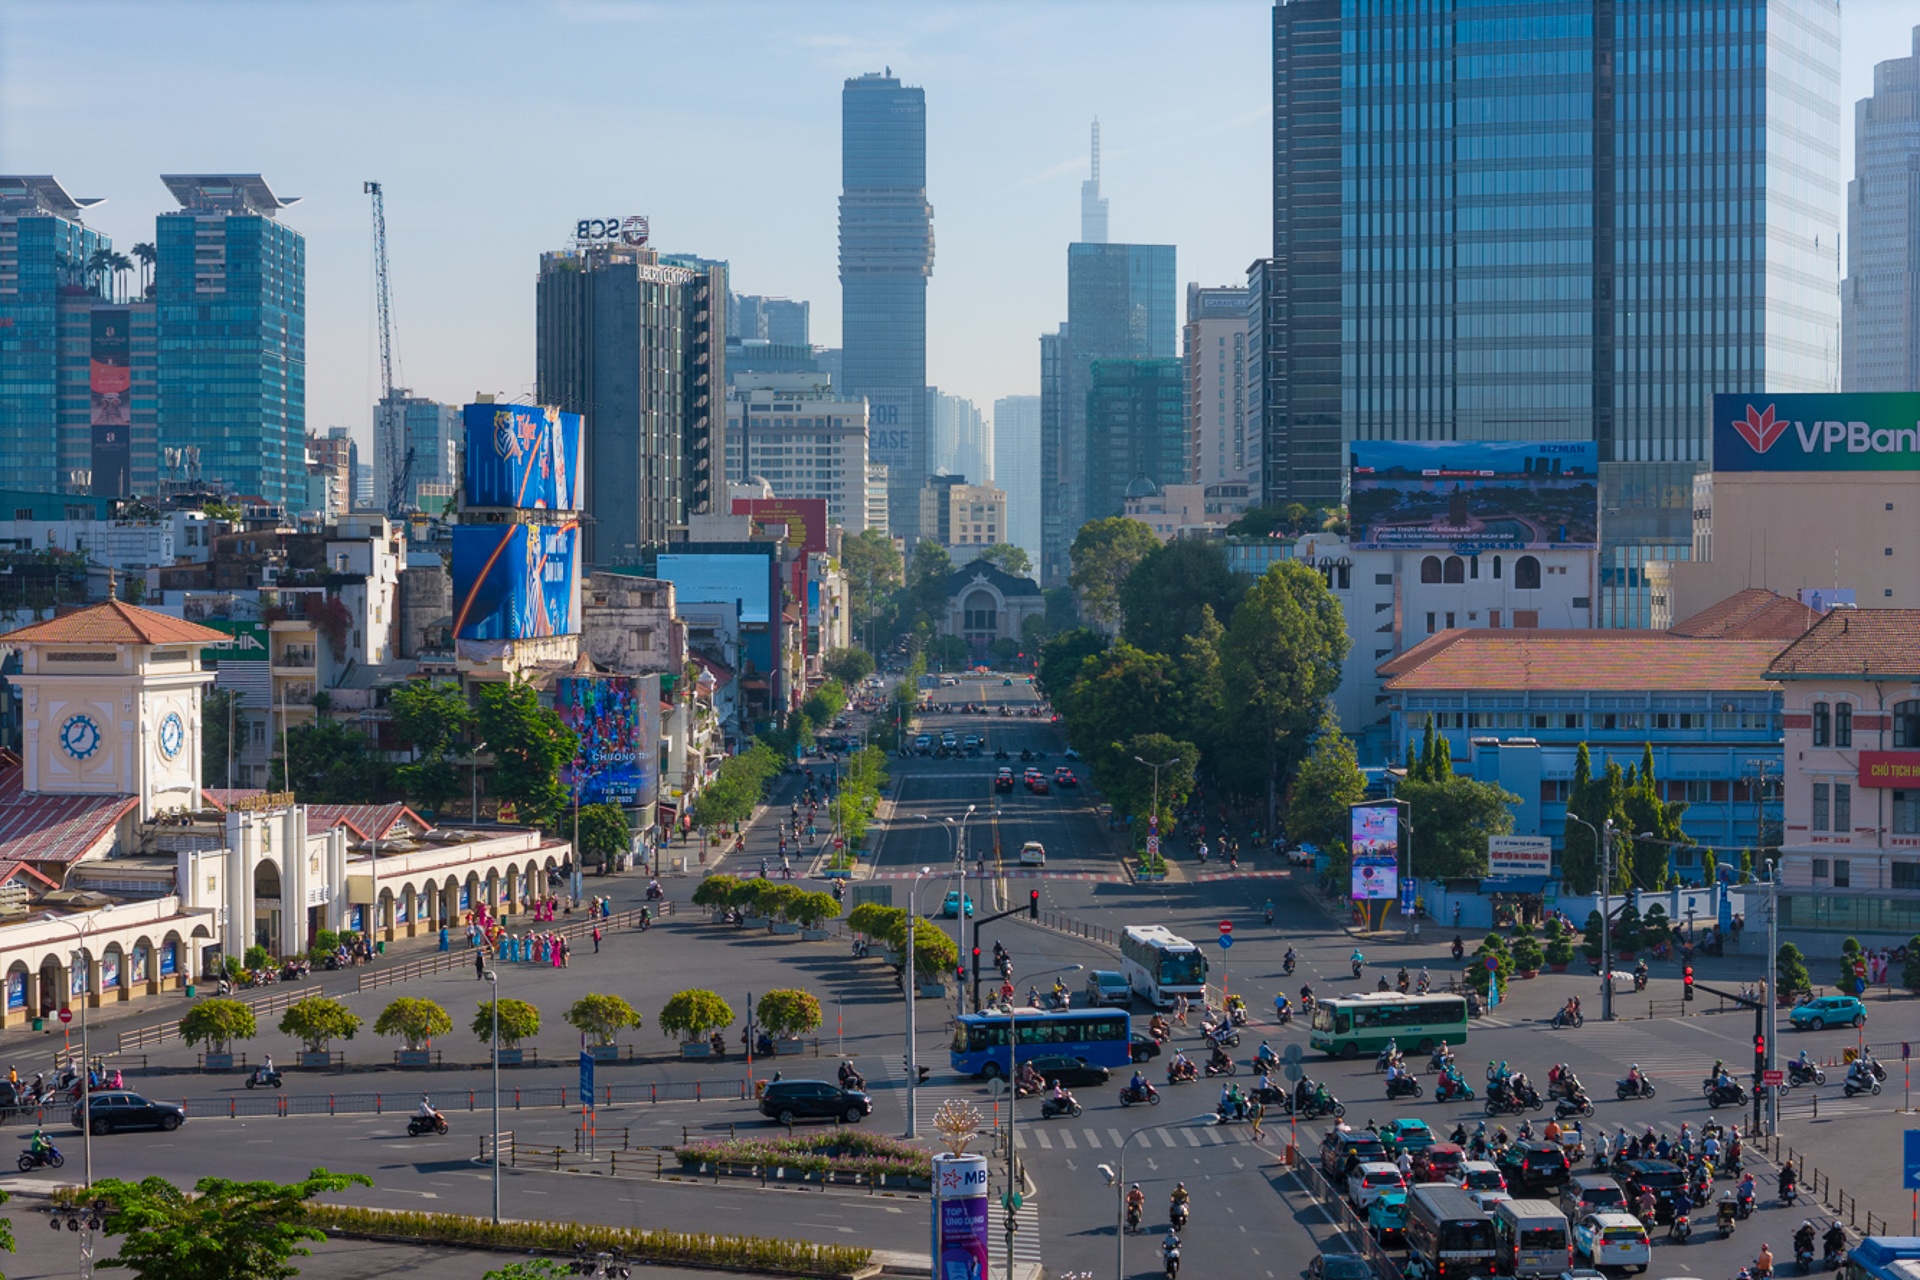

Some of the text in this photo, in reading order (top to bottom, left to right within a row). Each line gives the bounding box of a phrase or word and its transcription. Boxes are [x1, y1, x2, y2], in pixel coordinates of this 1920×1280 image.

[1794, 420, 1920, 453] VPBan
[1540, 445, 1585, 453] BIZMAN
[965, 1171, 986, 1185] MB
[945, 1207, 962, 1216] TOP
